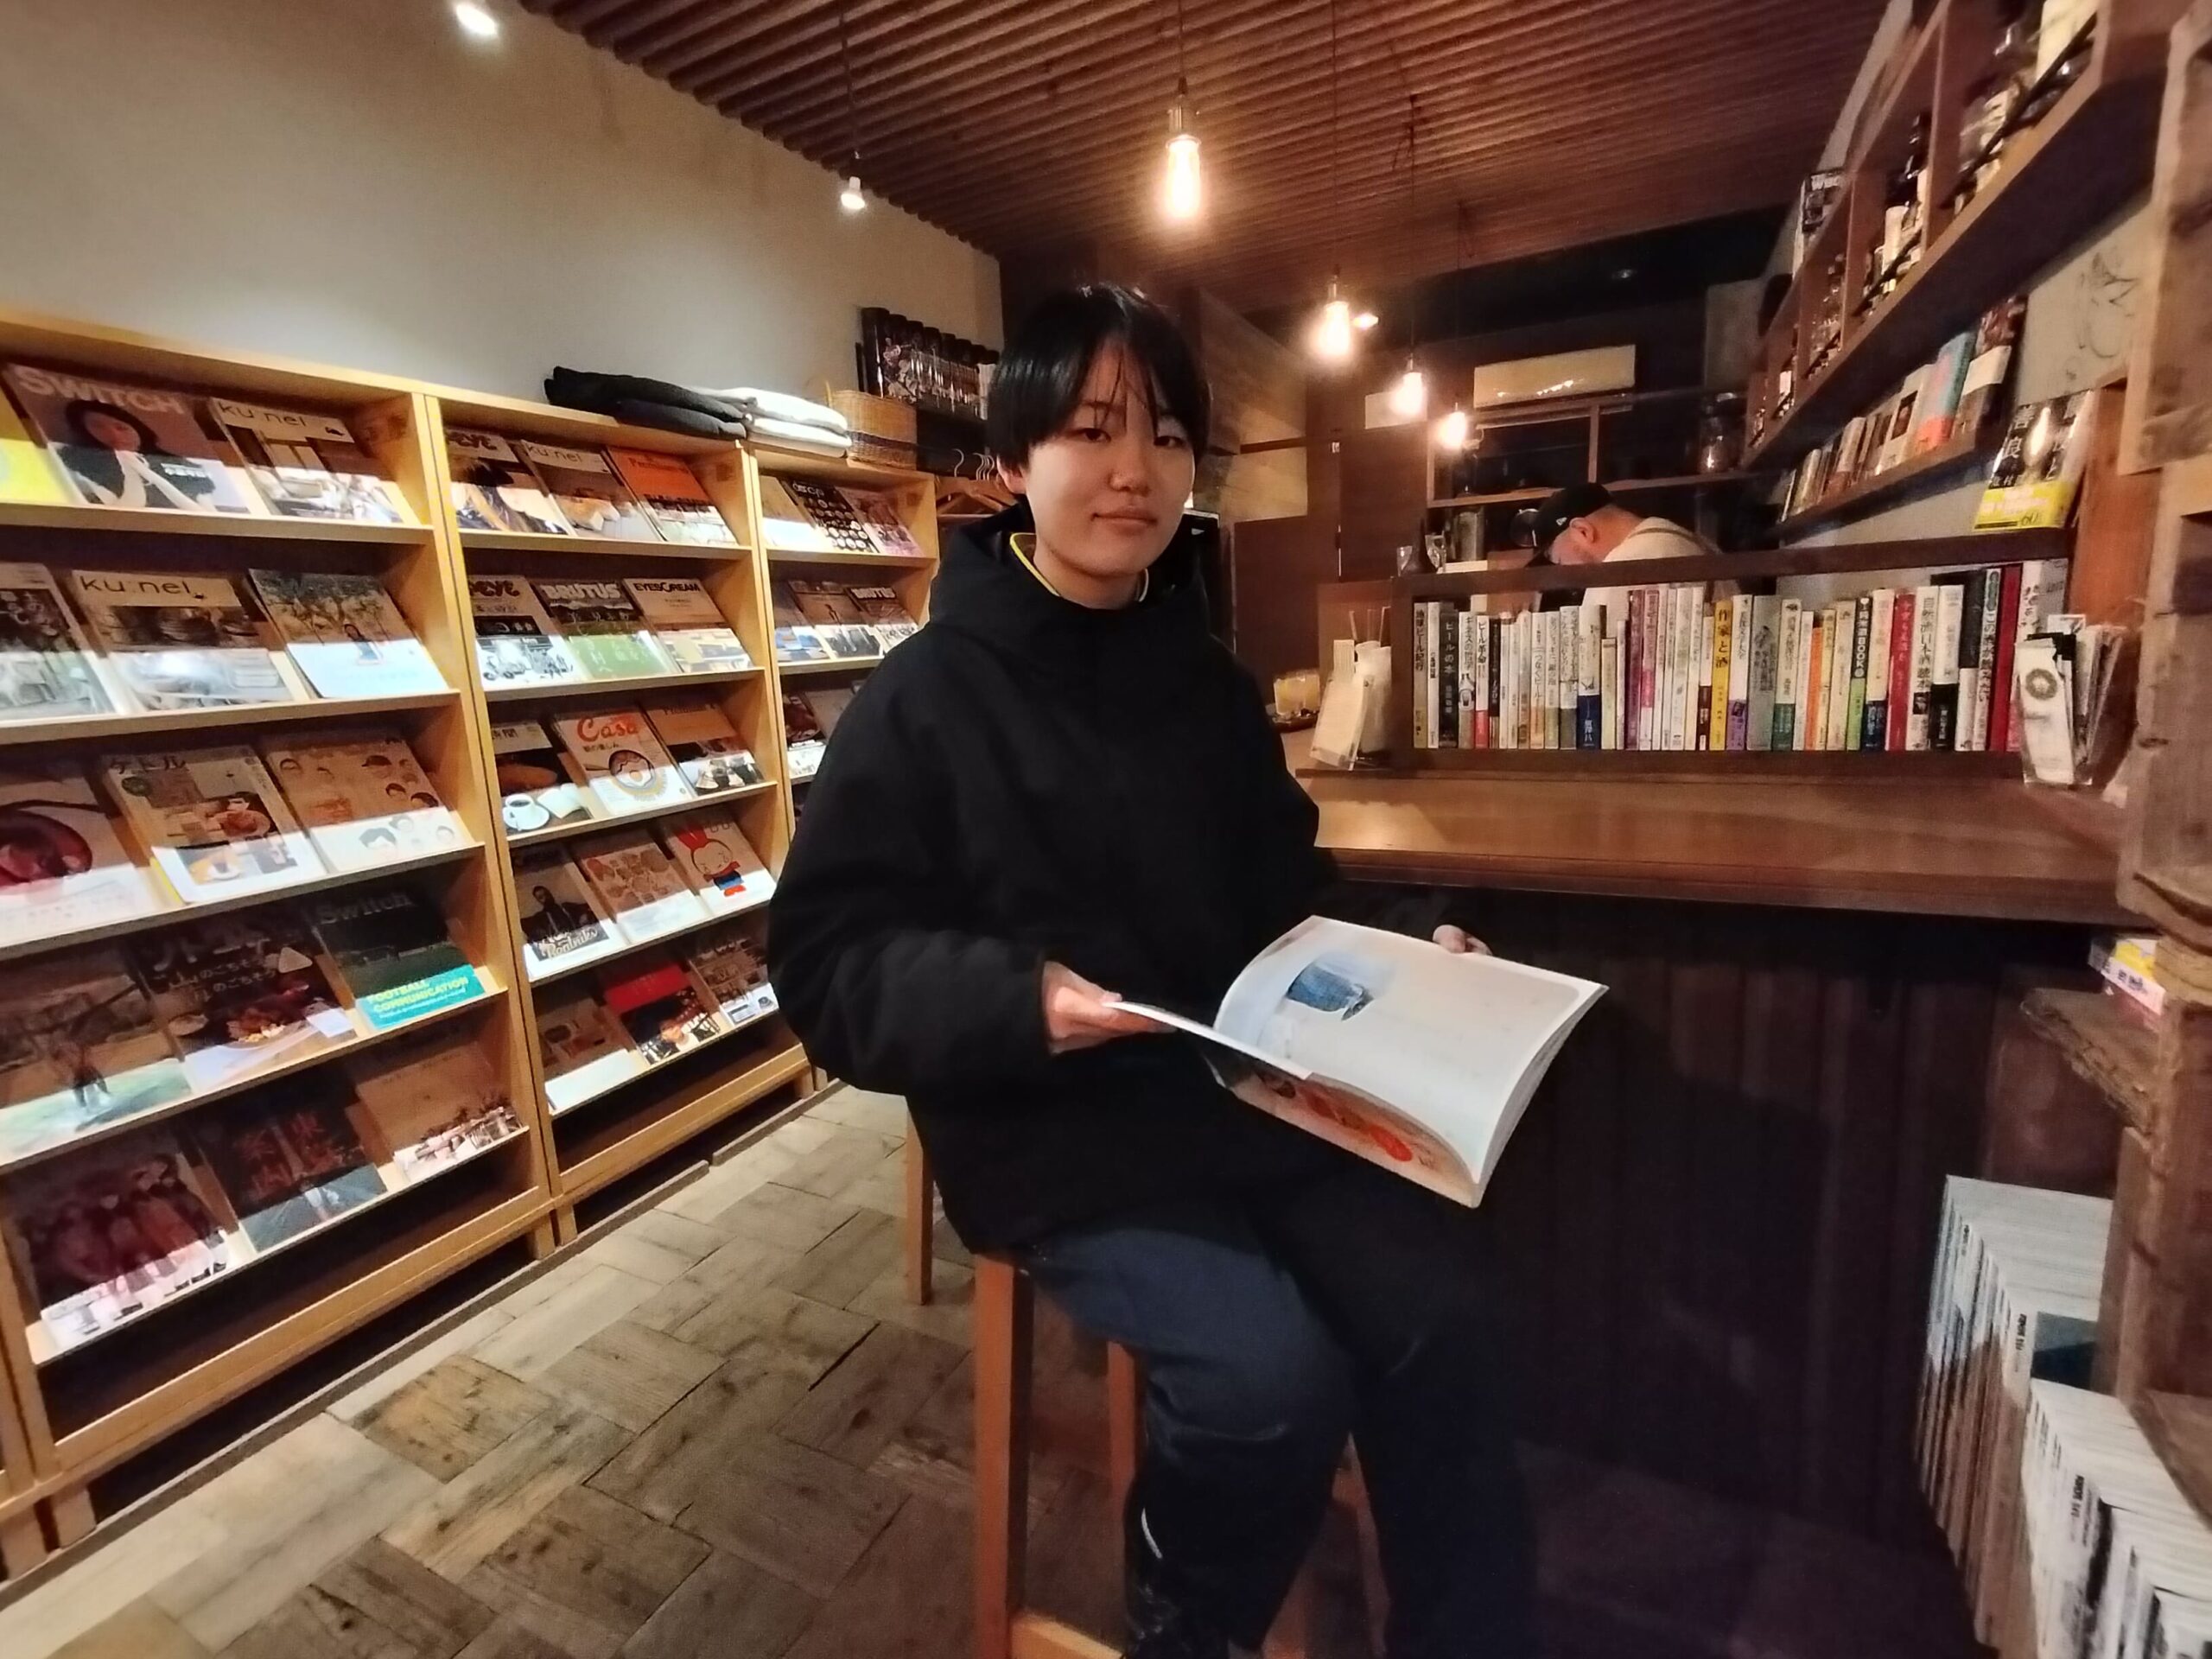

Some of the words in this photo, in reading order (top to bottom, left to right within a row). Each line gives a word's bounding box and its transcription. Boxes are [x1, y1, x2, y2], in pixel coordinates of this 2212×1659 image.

[15, 364, 184, 414] SWITCH
[540, 582, 621, 600] BRUTUS
[633, 582, 701, 594] EYESCREAM
[1444, 621, 1455, 675] ビールの本
[577, 715, 639, 742] Casa
[372, 976, 469, 1013] COMMUNICATION
